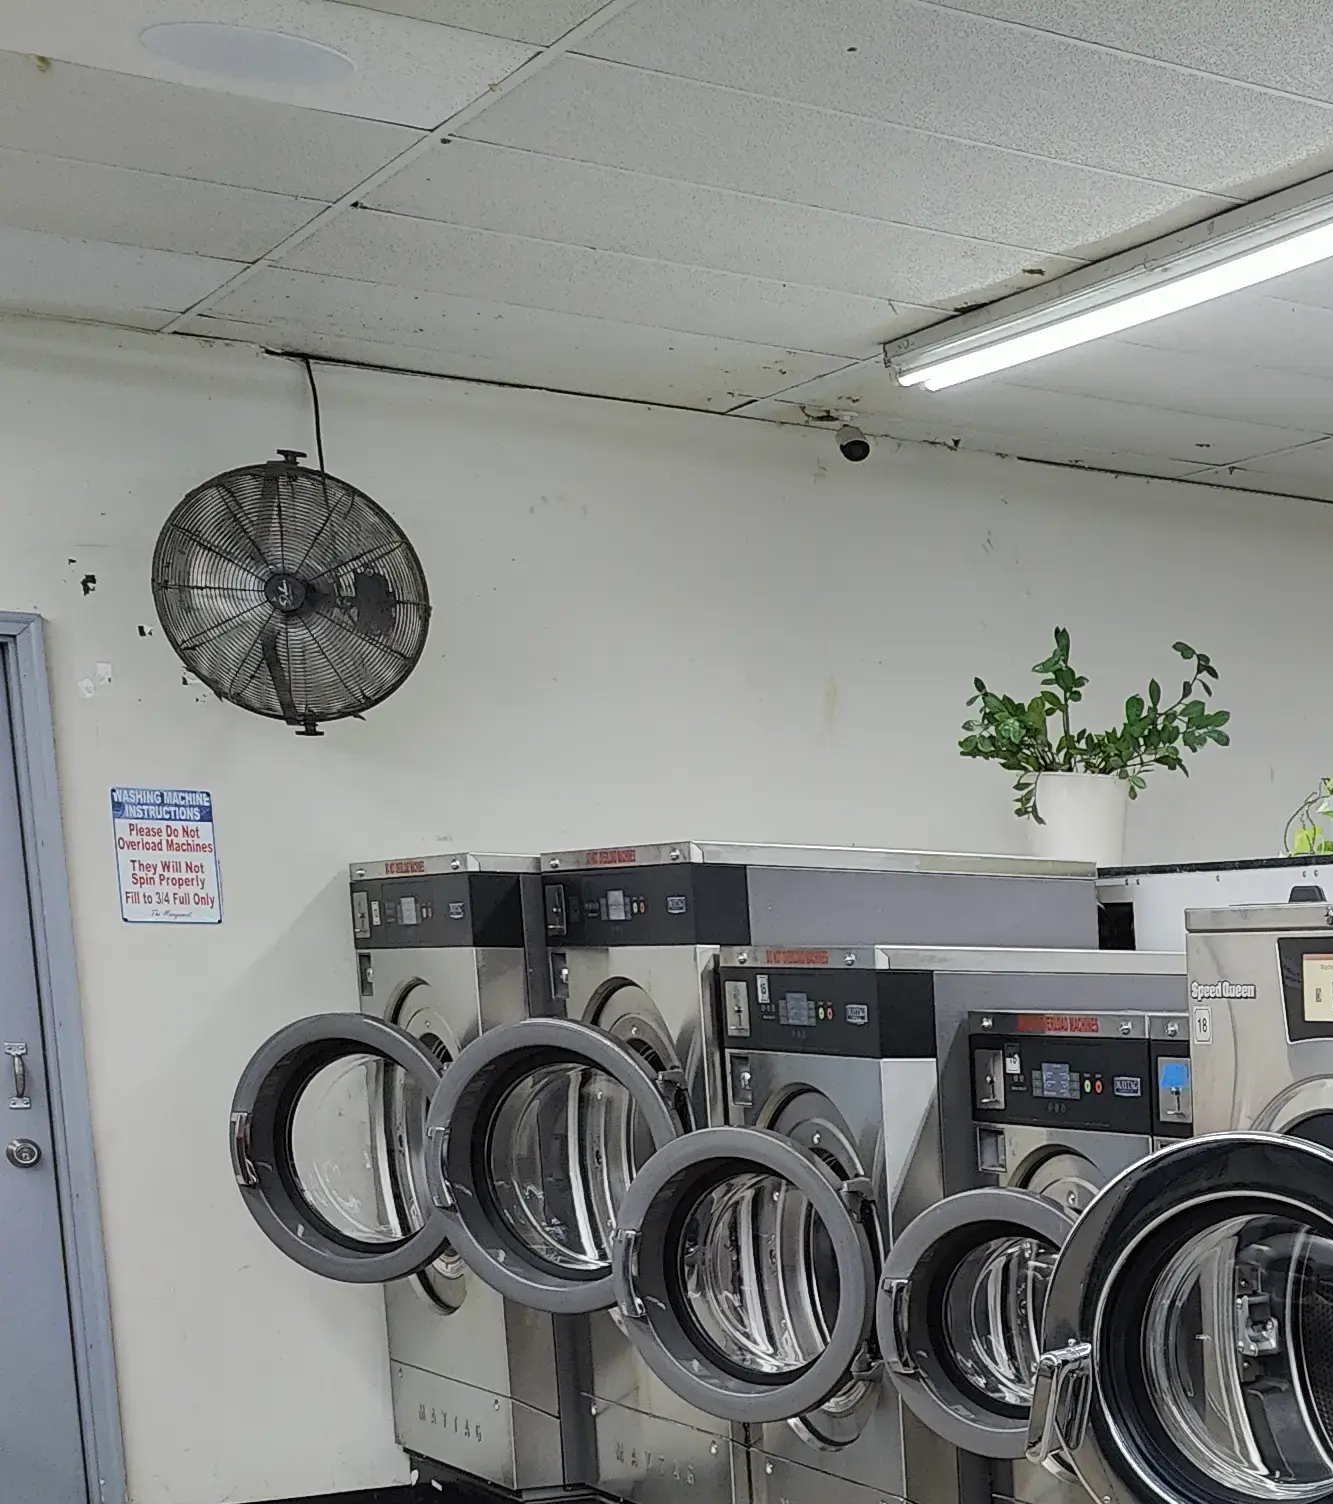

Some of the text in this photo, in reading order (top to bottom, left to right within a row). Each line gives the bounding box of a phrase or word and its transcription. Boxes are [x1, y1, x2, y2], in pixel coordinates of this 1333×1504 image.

[113, 788, 210, 806] WASHING MACHINE
[124, 805, 200, 820] INSTRUCTIONS
[129, 823, 200, 838] Please Do Not
[118, 837, 213, 853] Overload Machines
[130, 860, 205, 875] They Will Not
[131, 873, 206, 890] Spin Properly
[125, 891, 215, 909] Fill to 3/4 Full Only
[1190, 980, 1256, 1002] Speed Queen
[1197, 1018, 1207, 1033] 18
[419, 1404, 482, 1442] MAYTAG
